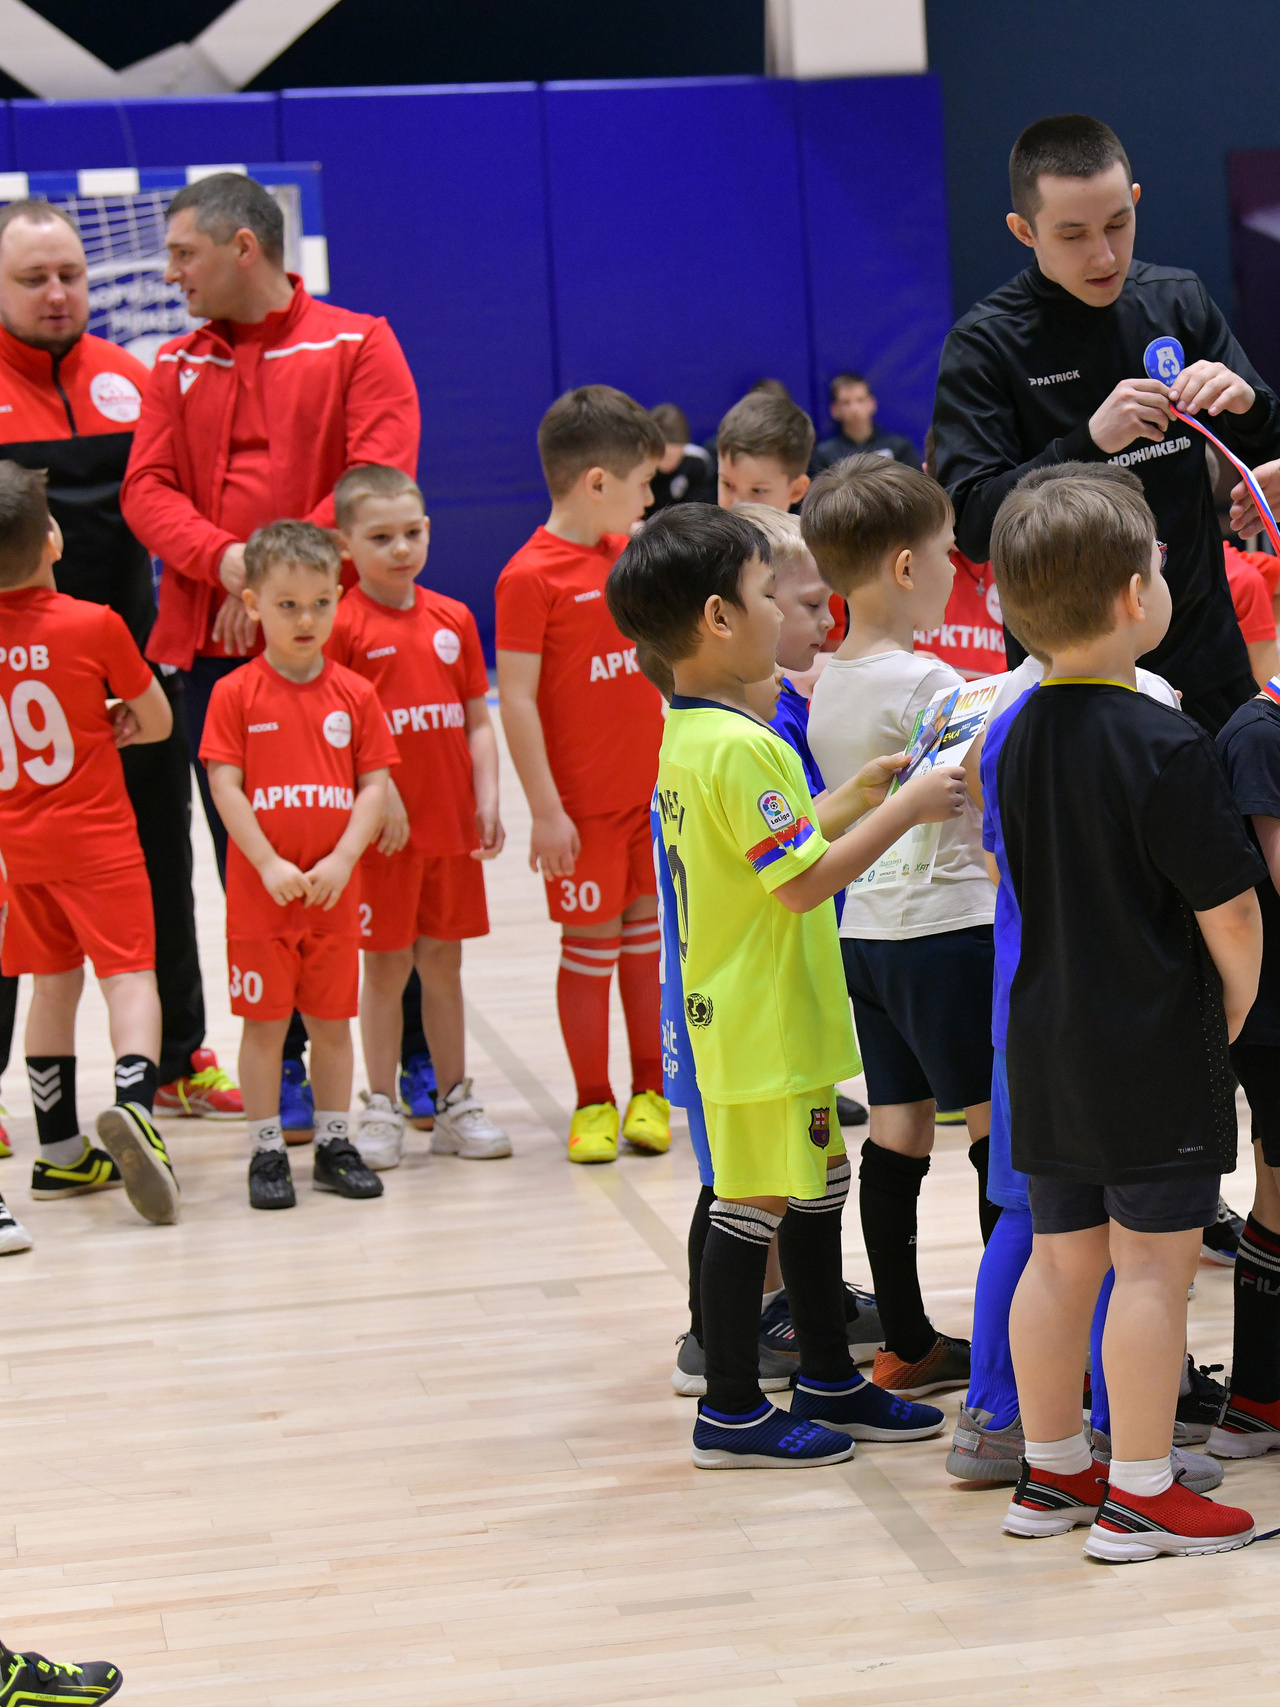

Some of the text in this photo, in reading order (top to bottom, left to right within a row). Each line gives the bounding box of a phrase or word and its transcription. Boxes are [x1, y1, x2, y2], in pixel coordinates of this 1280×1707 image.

[1036, 369, 1081, 387] PATRICK
[560, 879, 601, 913] 30
[230, 964, 264, 1004] 30
